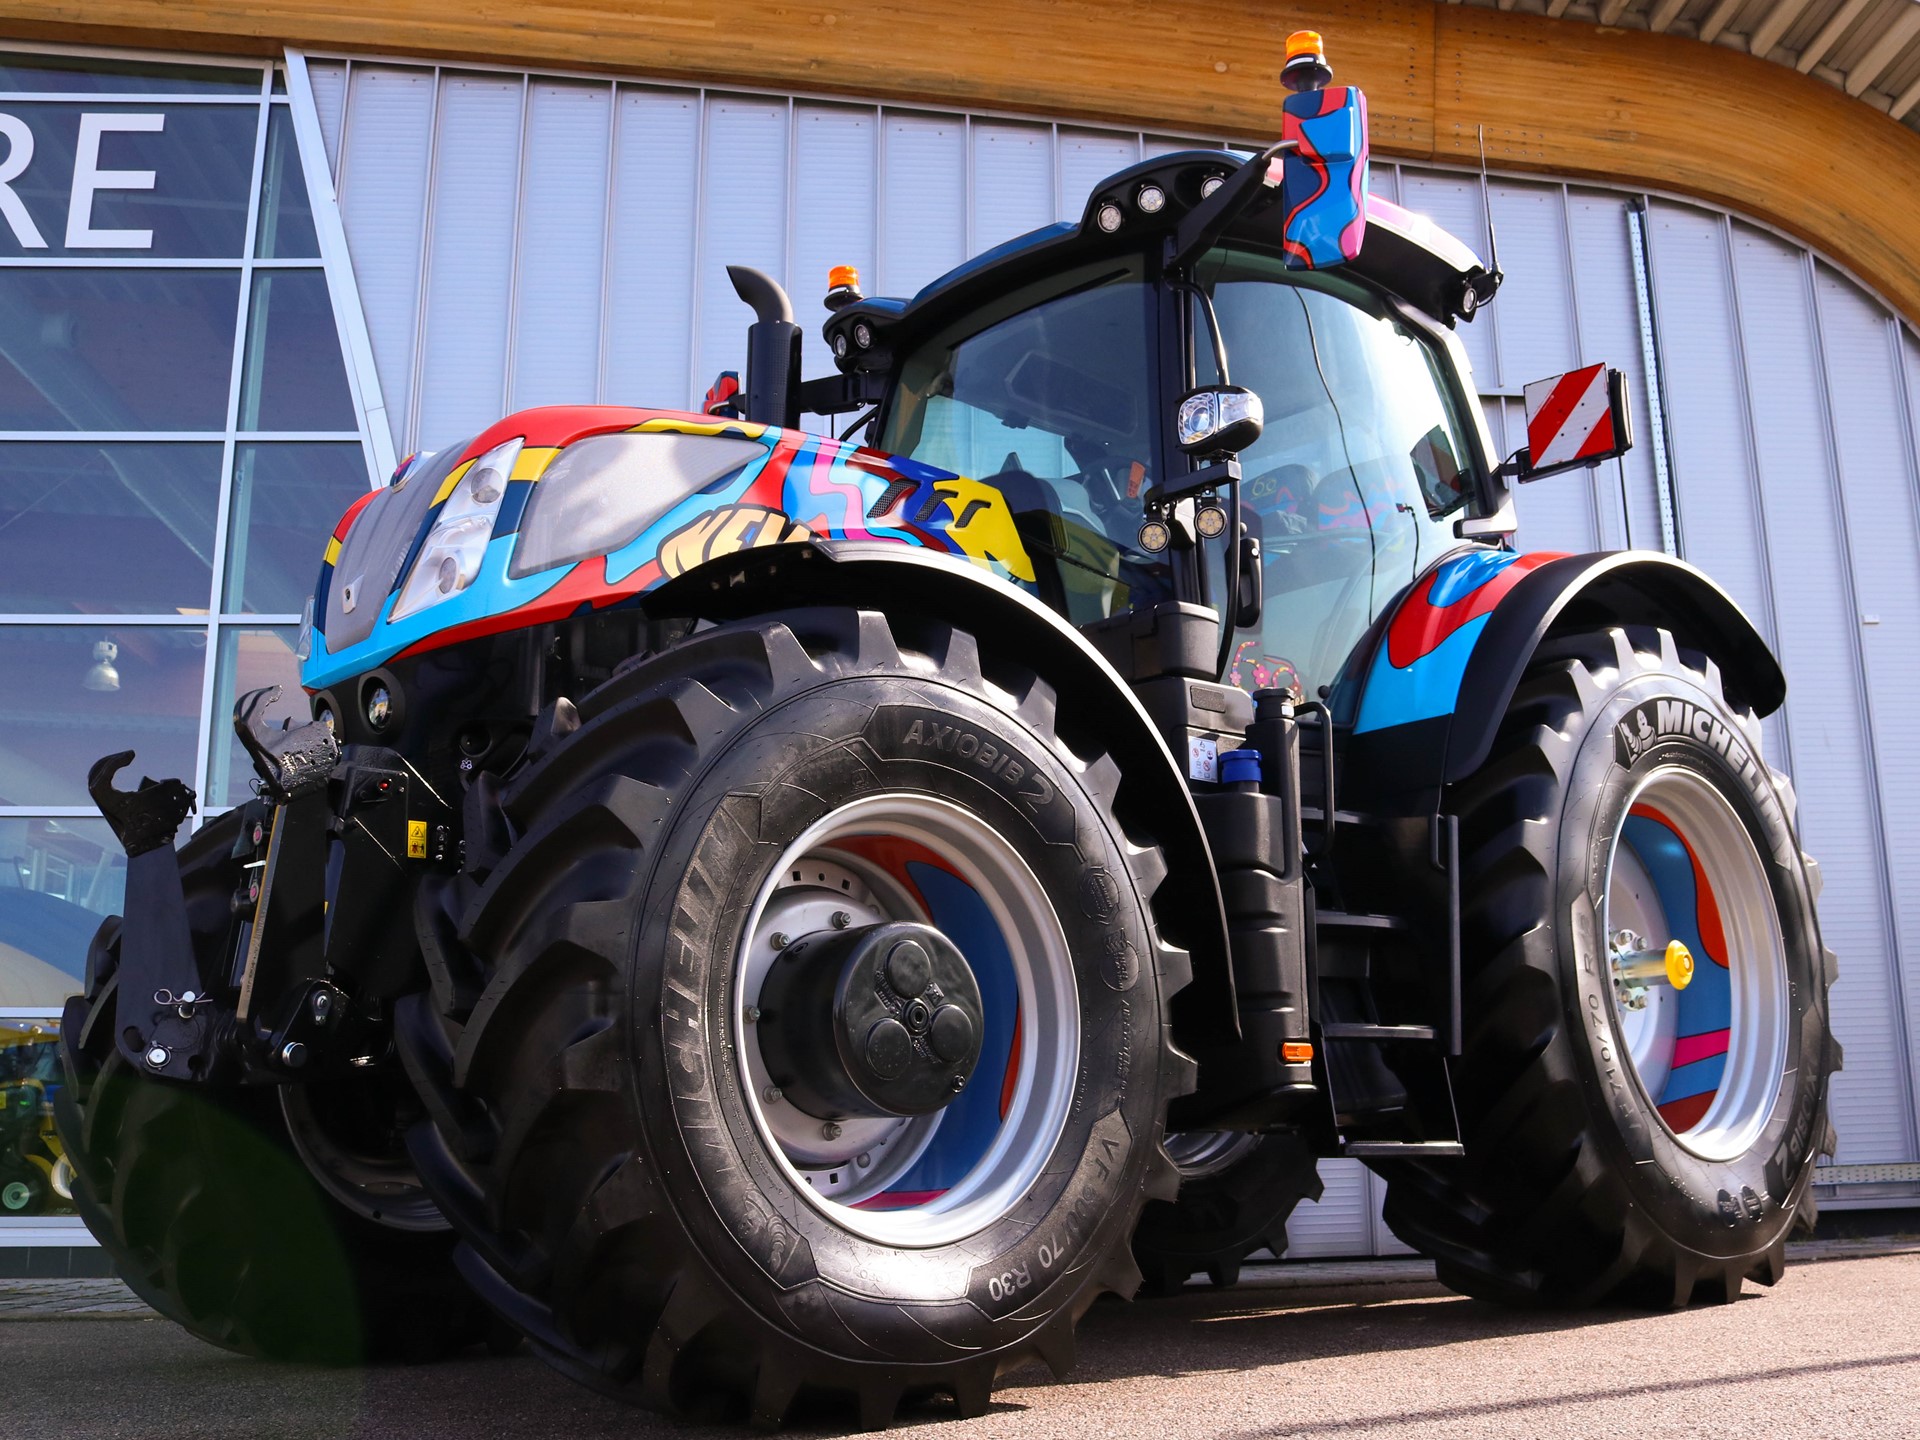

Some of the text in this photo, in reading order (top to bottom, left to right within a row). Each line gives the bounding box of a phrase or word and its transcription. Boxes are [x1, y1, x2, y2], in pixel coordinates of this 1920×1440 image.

[902, 719, 1054, 814] AXIOBIB 2
[1656, 699, 1793, 860] MICHELIN
[1588, 993, 1623, 1094] 710/70
[988, 1260, 1033, 1302] R30
